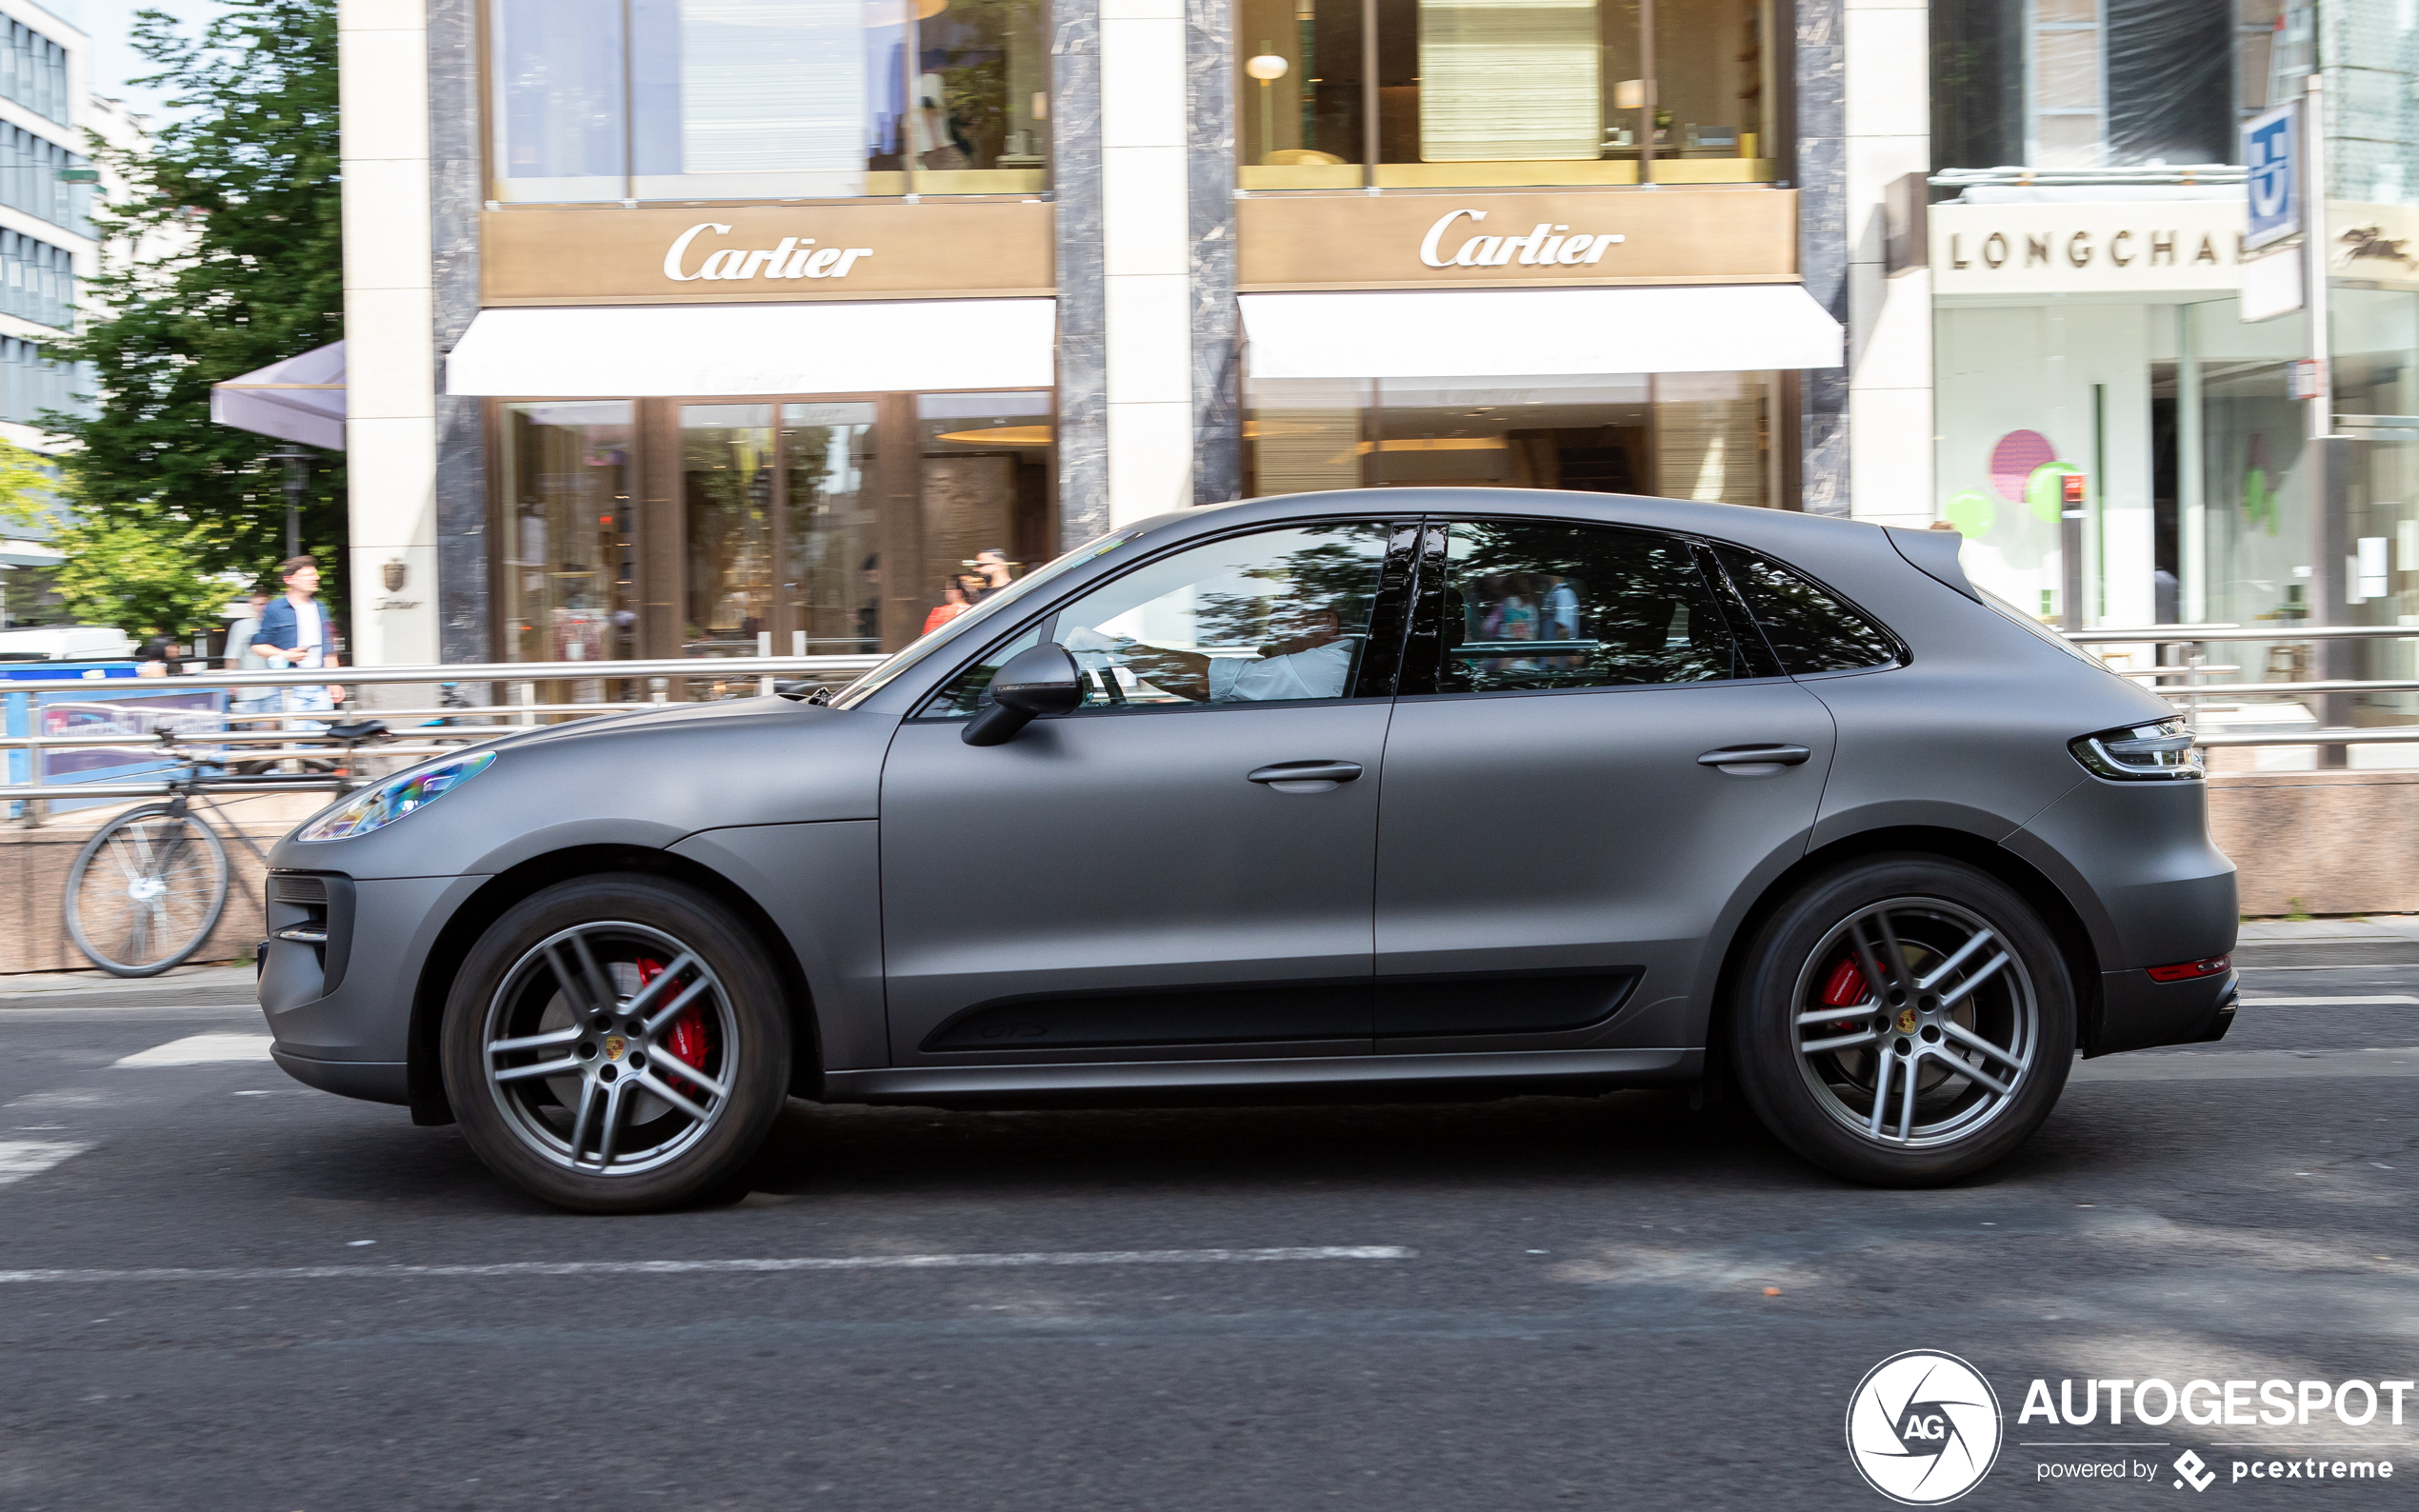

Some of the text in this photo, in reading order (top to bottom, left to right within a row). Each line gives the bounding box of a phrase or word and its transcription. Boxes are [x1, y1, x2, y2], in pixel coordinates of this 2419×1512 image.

[663, 222, 873, 281] Cartier
[1420, 209, 1626, 267] Cartier
[1949, 230, 2246, 270] LONGCHA
